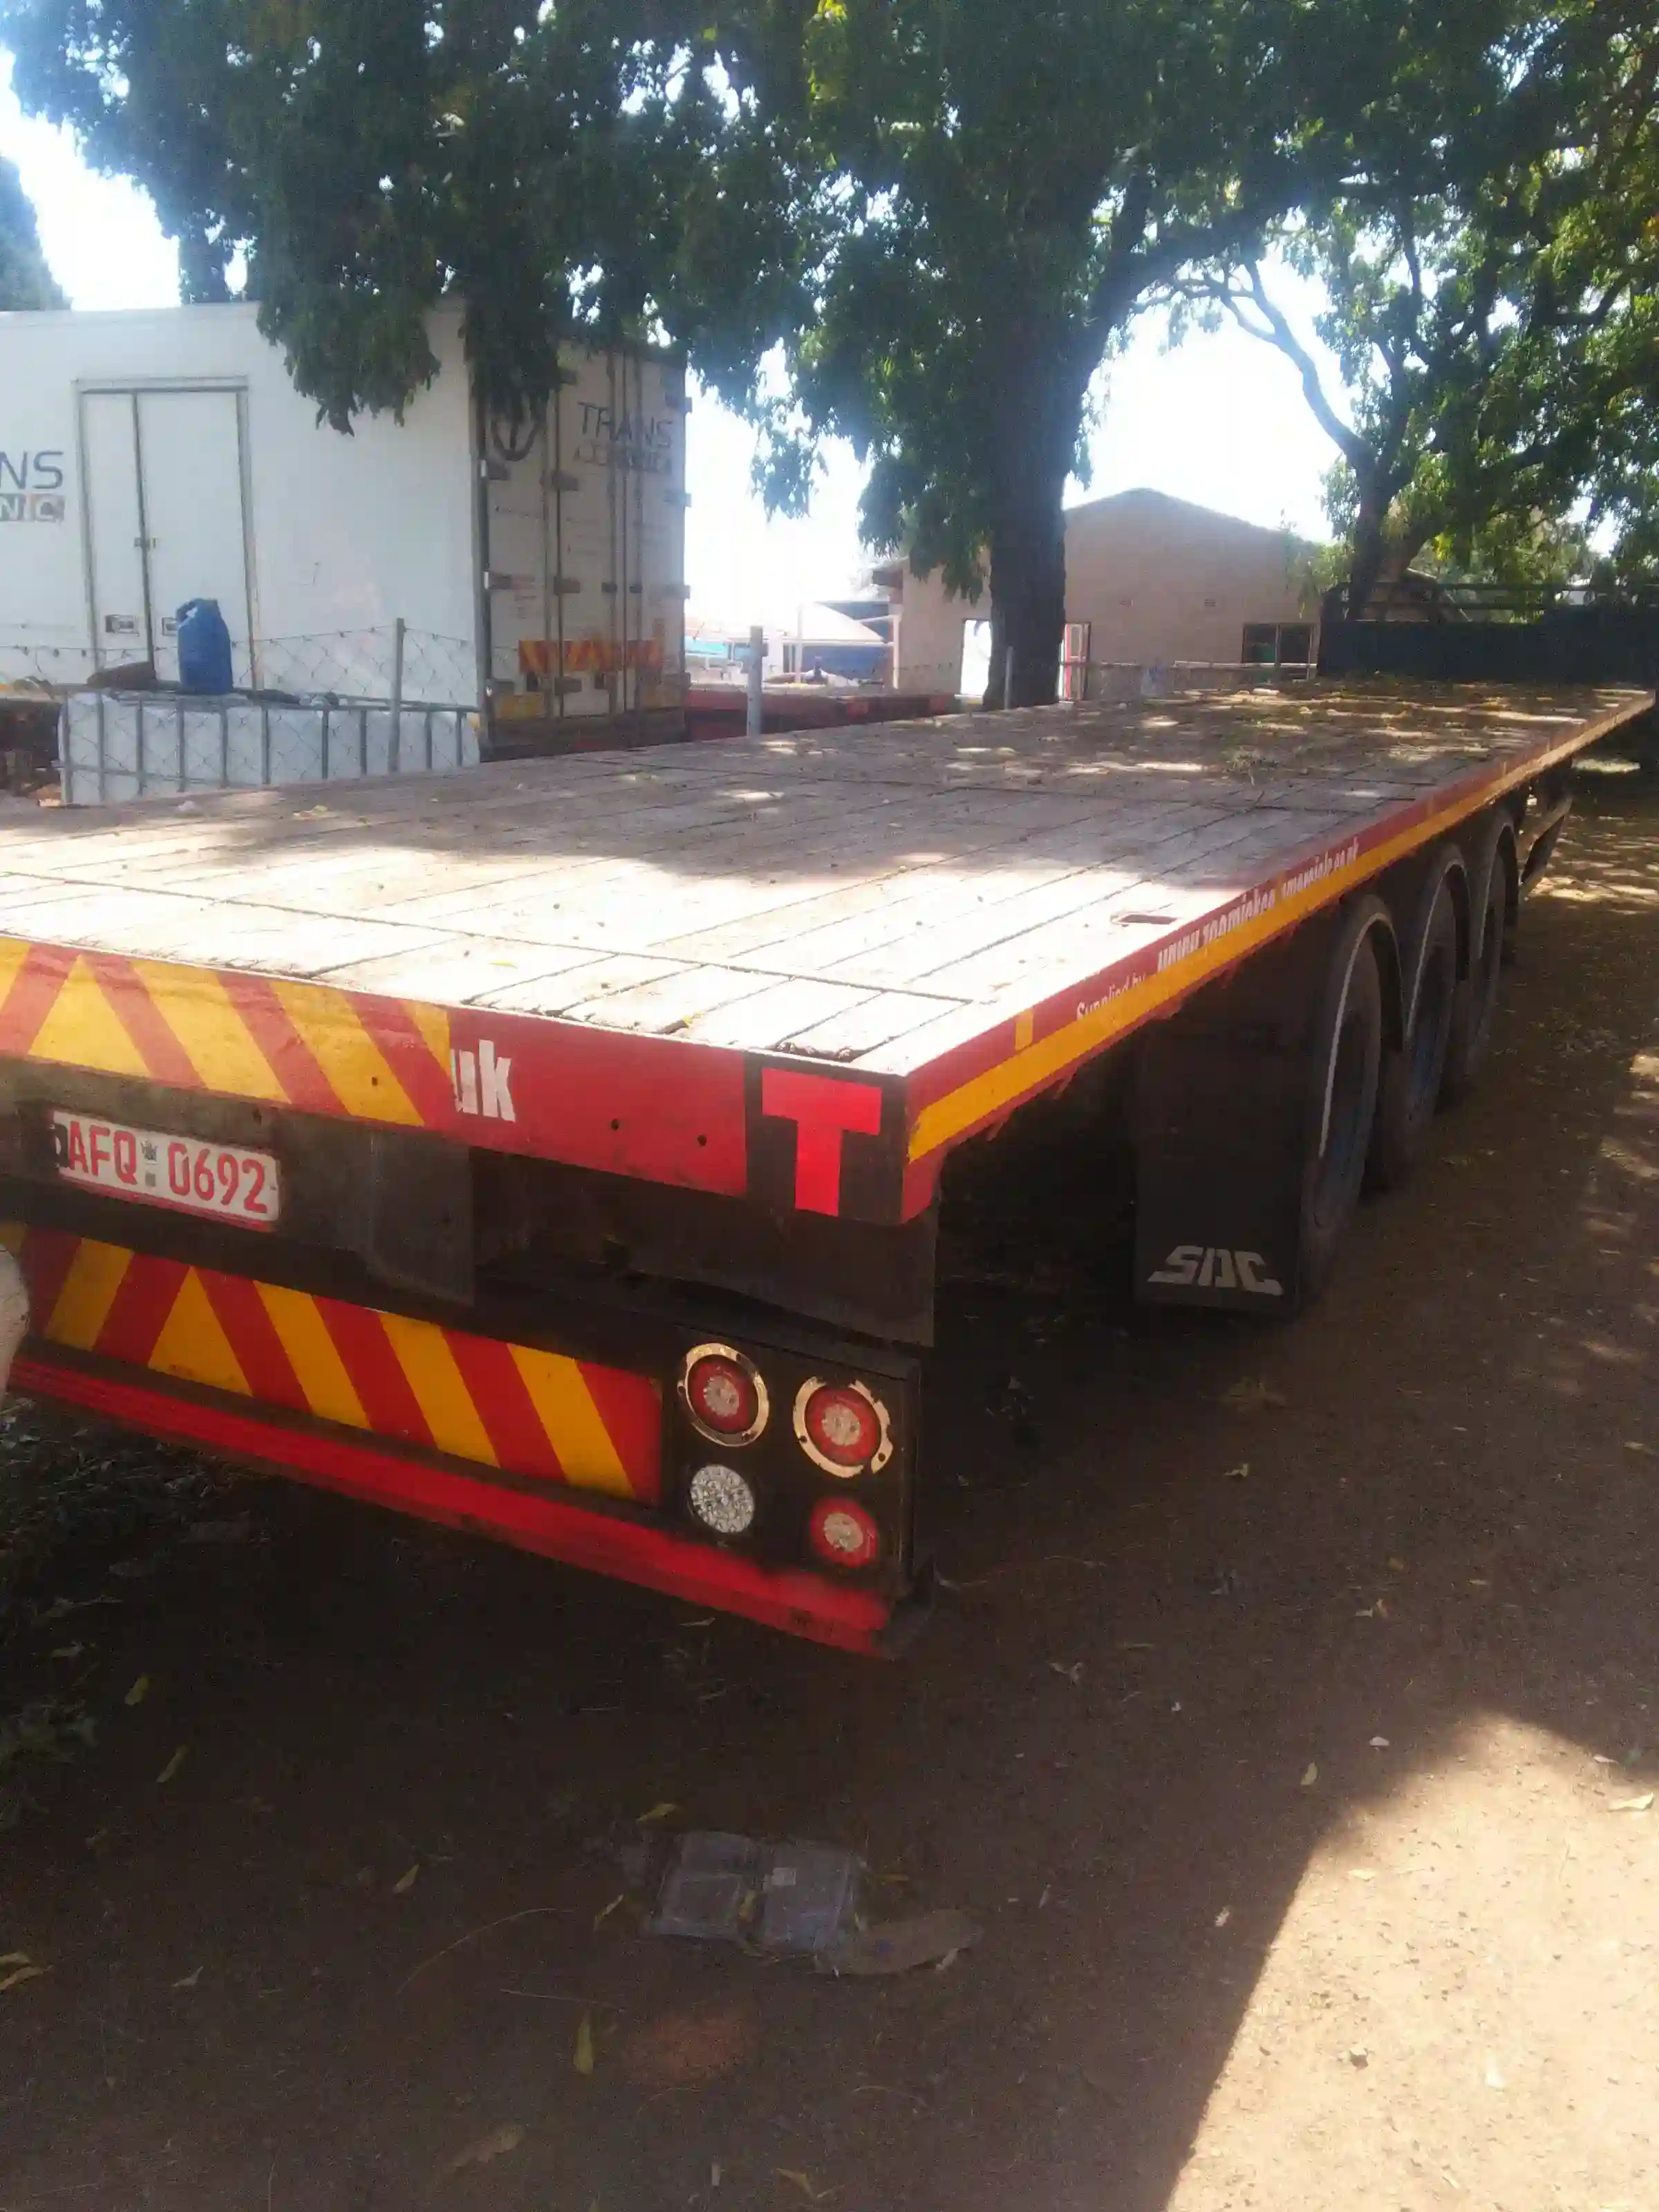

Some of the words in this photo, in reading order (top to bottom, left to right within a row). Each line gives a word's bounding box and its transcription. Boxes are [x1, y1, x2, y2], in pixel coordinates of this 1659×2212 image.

[0, 451, 64, 489] NS
[68, 1121, 138, 1185] AFQ
[167, 1142, 268, 1213] 0692
[762, 1068, 882, 1217] T
[1147, 1245, 1284, 1296] SDC
